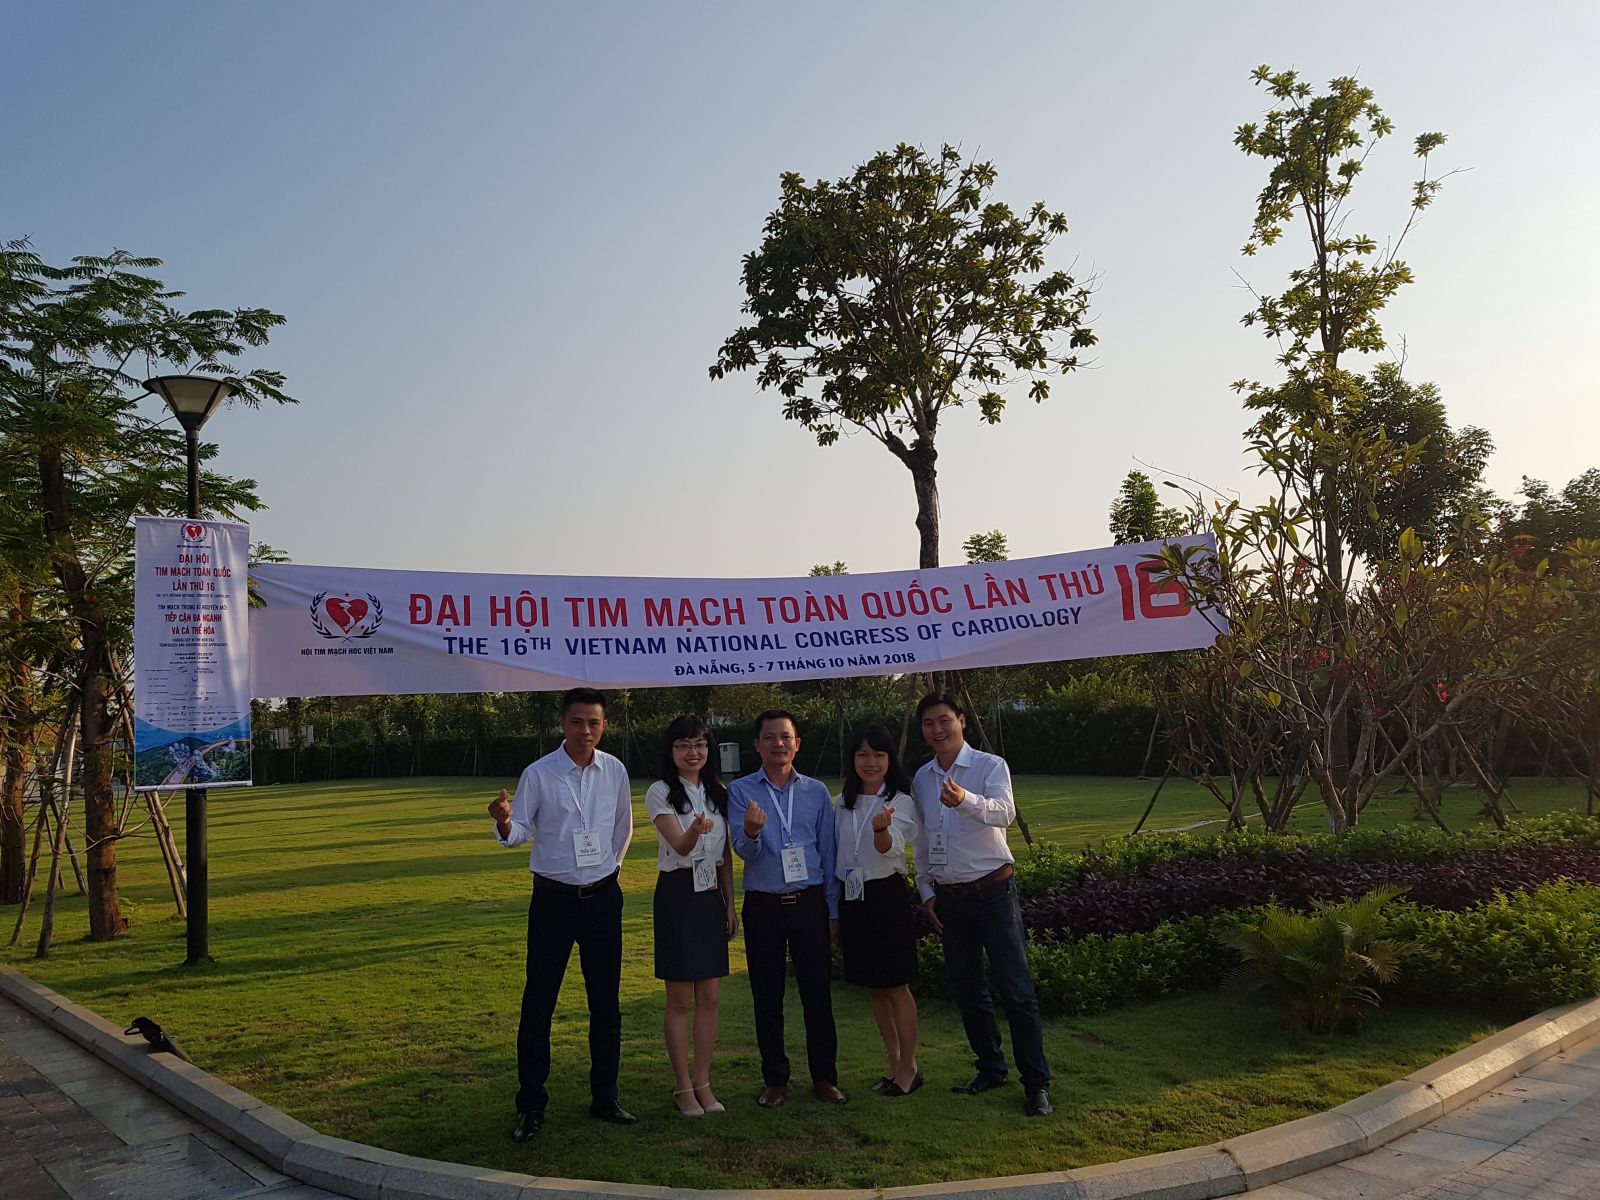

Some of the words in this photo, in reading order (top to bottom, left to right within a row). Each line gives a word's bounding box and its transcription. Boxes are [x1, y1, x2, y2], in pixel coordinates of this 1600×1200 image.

[179, 553, 192, 564] ĐẠI
[196, 553, 209, 566] HỘI
[155, 566, 168, 576] TIM
[170, 567, 190, 578] MẠCH
[193, 566, 210, 576] TOÀN
[213, 565, 232, 578] QUỐC
[172, 578, 188, 591] LẦN
[206, 582, 215, 592] 16
[409, 593, 471, 632] ĐẠI
[490, 590, 550, 633] HỘI
[564, 597, 628, 628] TIM
[644, 597, 746, 633] MẠCH
[757, 590, 848, 624] TOÀN
[861, 579, 953, 620] QUỐC
[964, 572, 1030, 610] LẦN
[1038, 563, 1105, 601] THỨ
[1114, 559, 1191, 621] 16
[443, 636, 489, 656] THE
[500, 636, 551, 656] 16TH
[566, 637, 666, 656] VIETNAM
[676, 633, 786, 654] NATIONAL
[794, 626, 910, 649] CONGRESS
[918, 623, 942, 640] OF
[952, 606, 1082, 637] CARDIOLOGY
[301, 648, 312, 656] HỘI
[328, 648, 347, 656] MẠCH
[349, 648, 362, 656] HỌC
[364, 646, 377, 655] VIỆT
[674, 662, 695, 676] ĐÀ
[698, 659, 745, 676] NẴNG,
[748, 662, 756, 673] 5
[767, 661, 775, 672] 7
[777, 657, 826, 671] THÁNG
[829, 657, 844, 668] 10
[848, 654, 880, 667] NĂM
[884, 652, 916, 664] 2018
